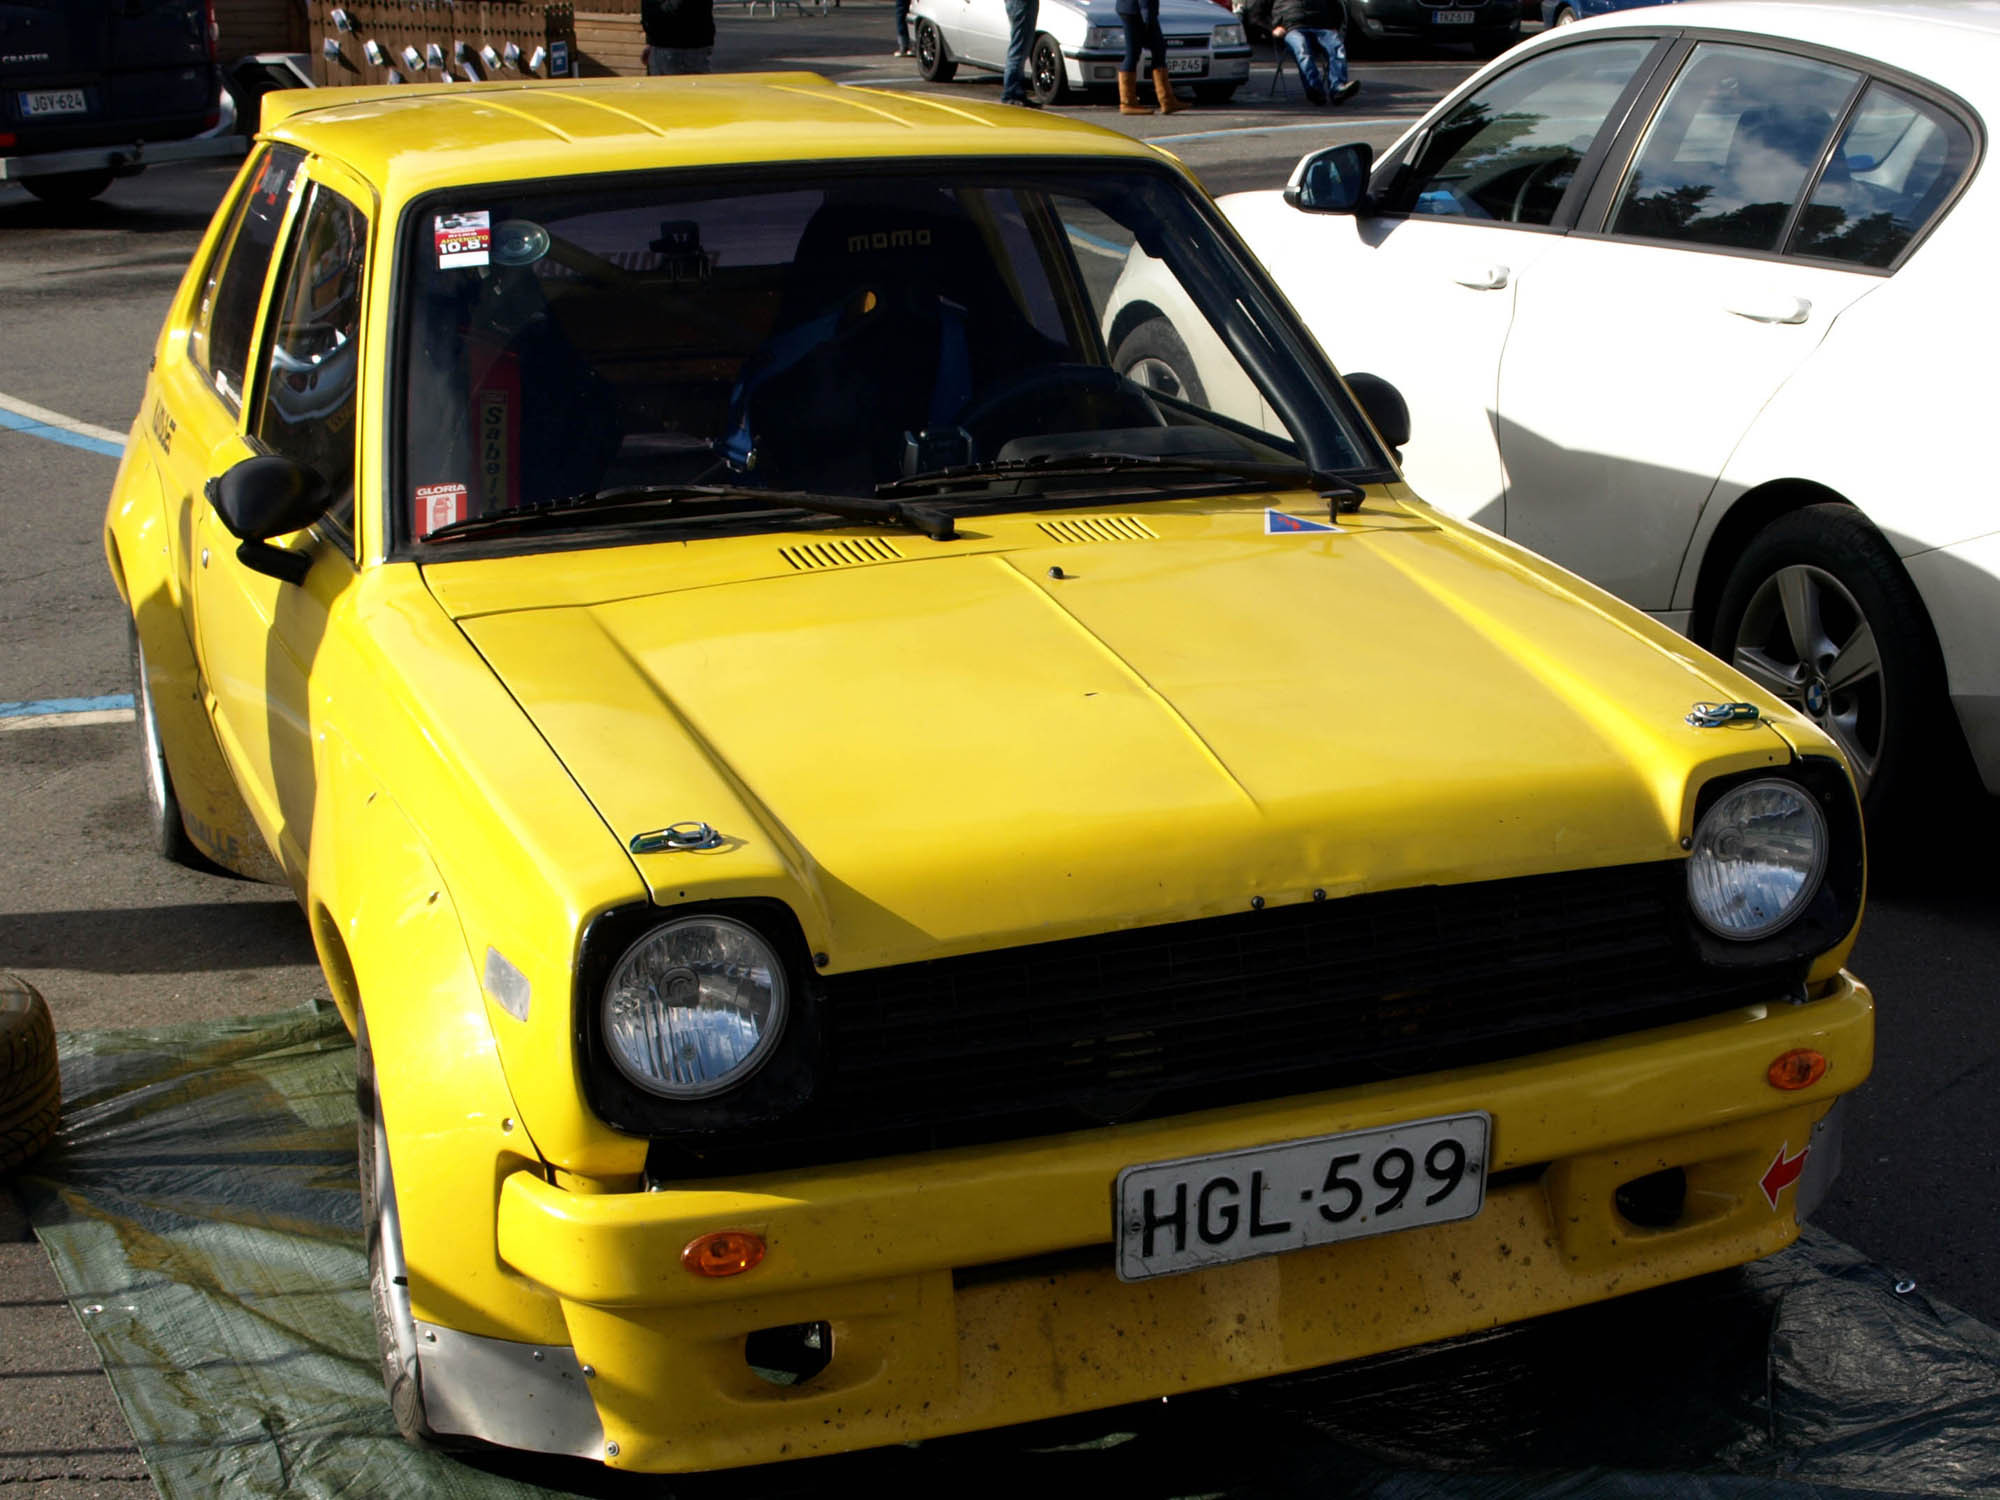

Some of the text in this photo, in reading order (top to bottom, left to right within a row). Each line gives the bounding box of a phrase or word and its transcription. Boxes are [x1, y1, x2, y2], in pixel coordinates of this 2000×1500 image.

[32, 93, 82, 112] JGV-624
[847, 228, 932, 253] momo
[417, 484, 466, 496] GLORIA
